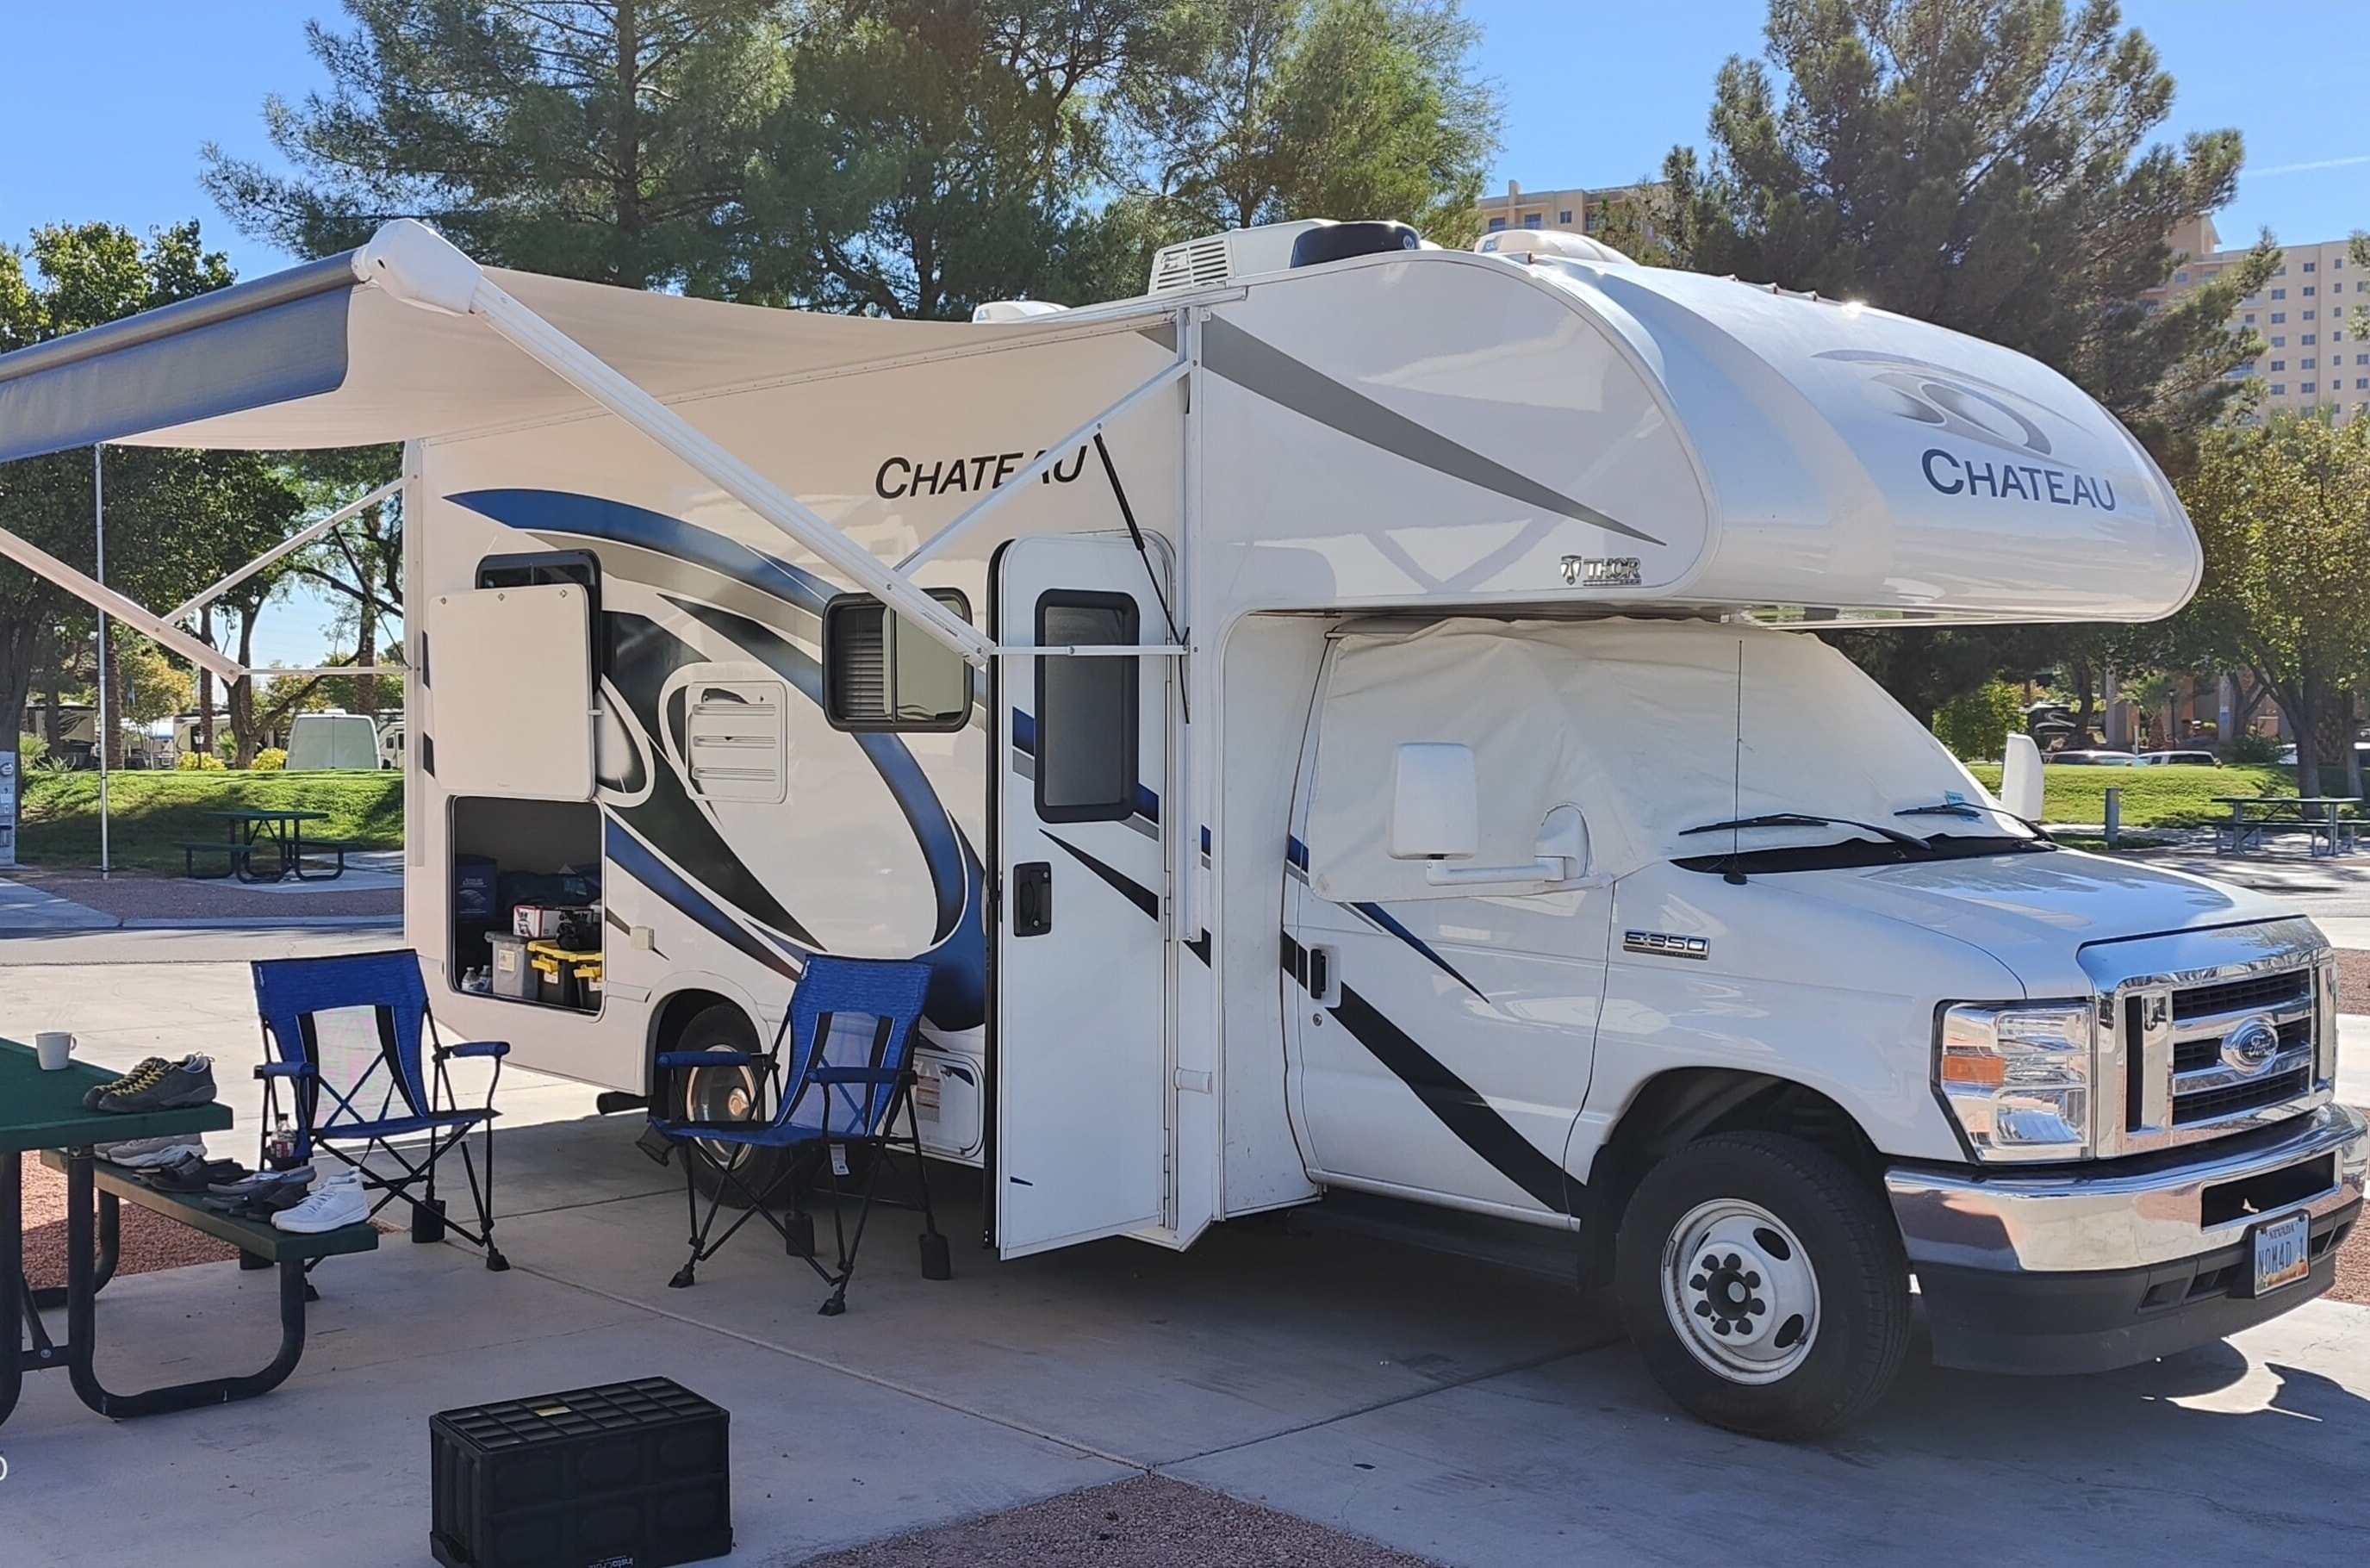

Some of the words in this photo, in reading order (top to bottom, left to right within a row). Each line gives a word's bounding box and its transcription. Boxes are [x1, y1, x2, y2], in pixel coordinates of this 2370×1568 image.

[1921, 448, 2116, 512] CHATEAU
[1583, 557, 1641, 580] THOR
[2268, 1223, 2295, 1240] NEVADA
